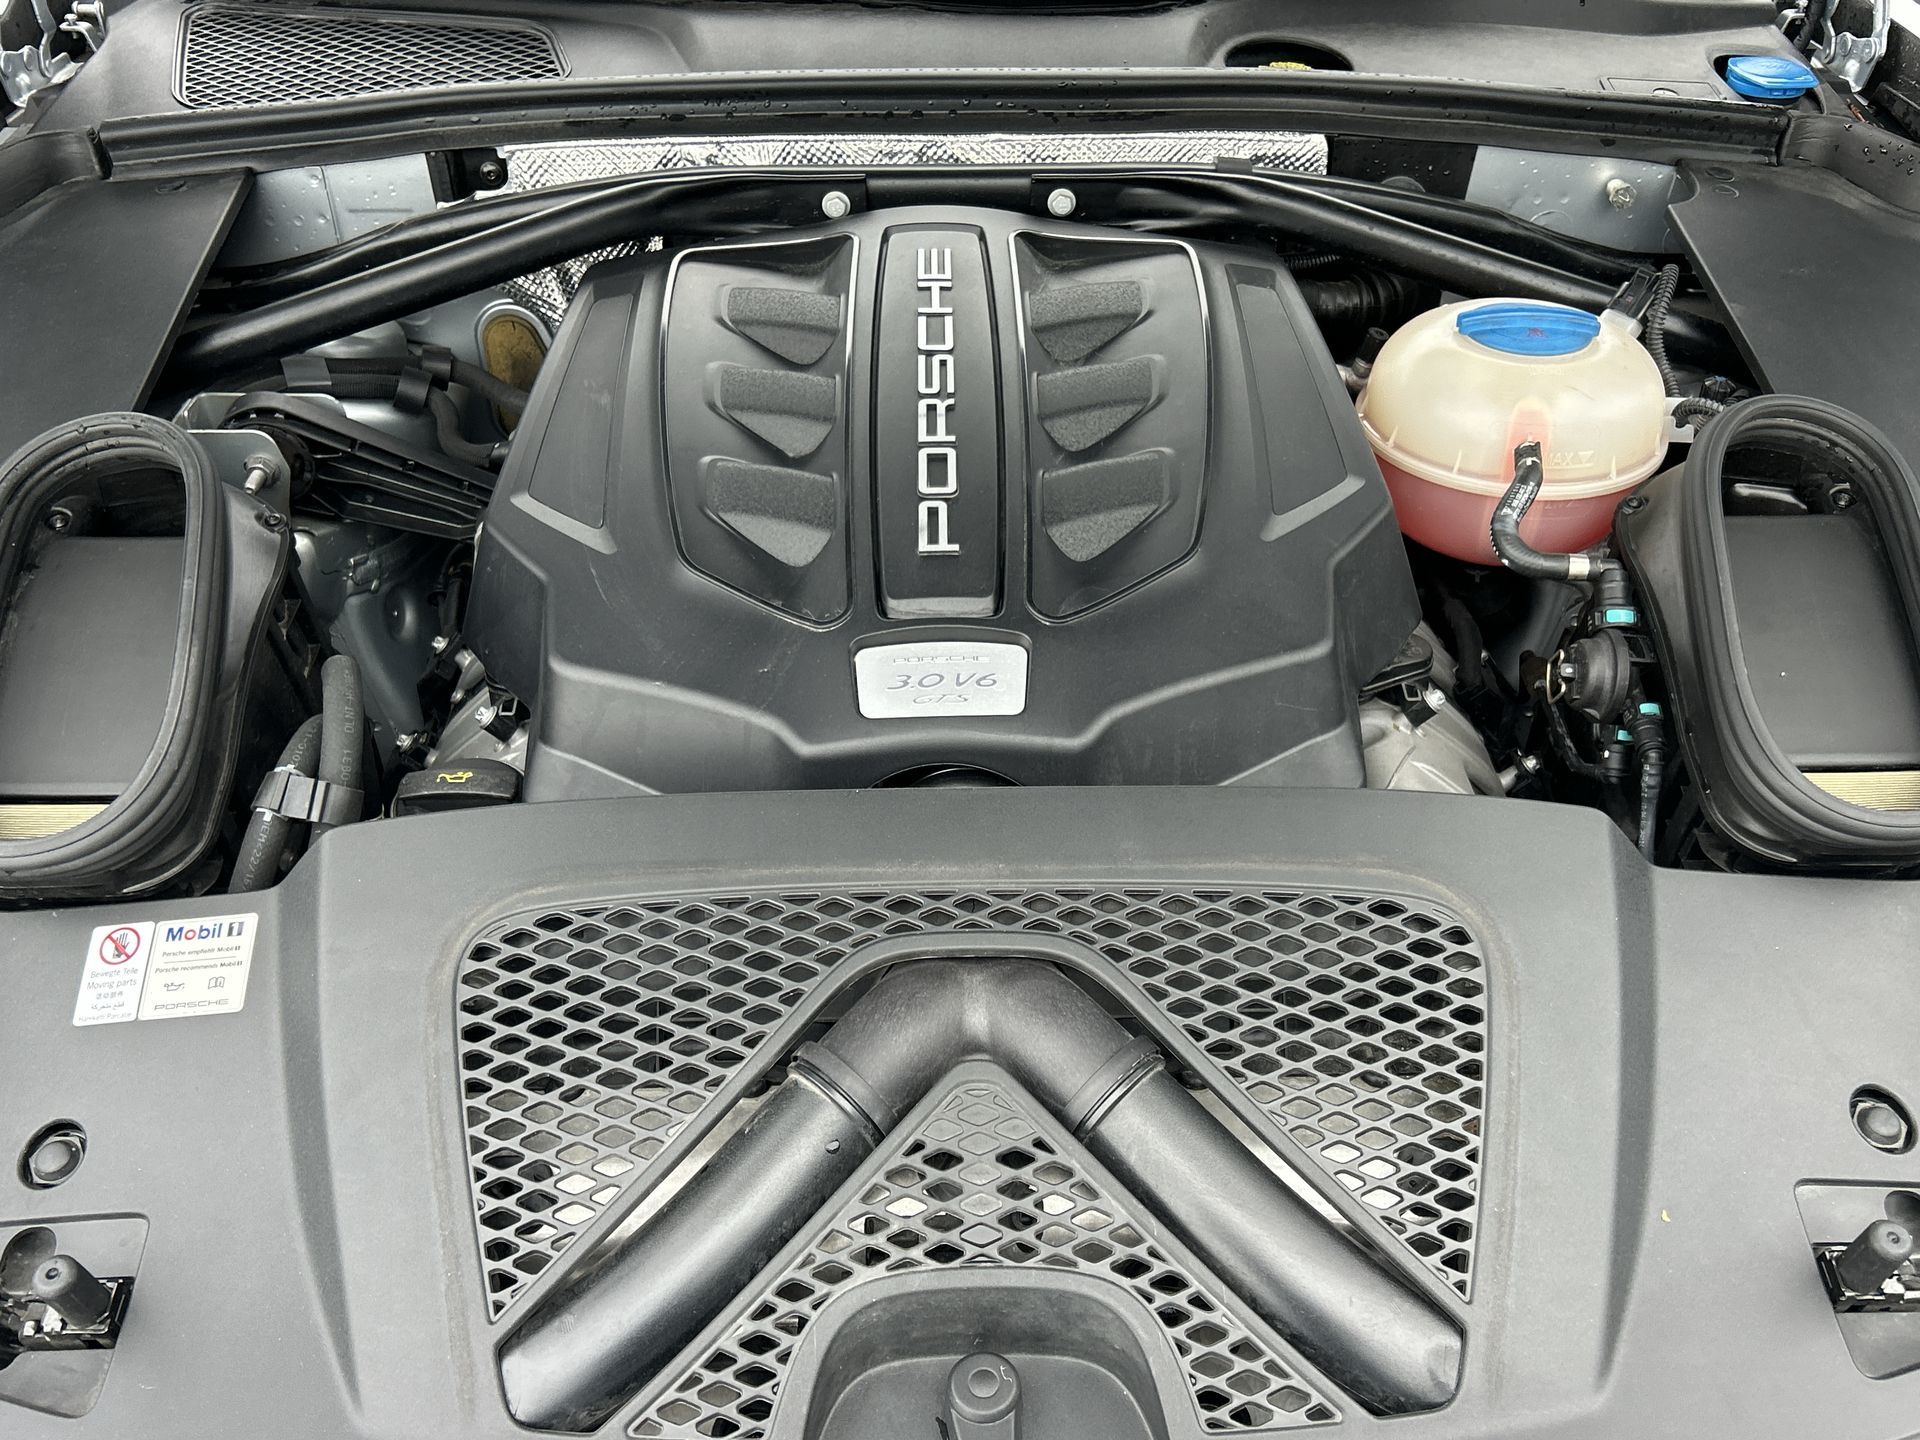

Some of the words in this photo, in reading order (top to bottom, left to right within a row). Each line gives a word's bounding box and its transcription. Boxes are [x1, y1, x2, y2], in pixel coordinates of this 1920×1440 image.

[917, 248, 960, 555] PORSCHE
[893, 655, 990, 664] PORSCHE
[887, 673, 945, 690] 3.0
[955, 672, 998, 688] V6
[913, 694, 969, 704] GTS
[165, 923, 223, 942] Mobil
[226, 921, 245, 938] 1
[162, 948, 186, 957] Porsche
[217, 945, 234, 953] Mobil
[90, 968, 120, 979] Bewegte
[124, 967, 138, 975] Teile
[155, 966, 179, 974] Porsche
[180, 963, 218, 972] recommends
[87, 981, 115, 990] Moving
[116, 979, 137, 988] parts
[153, 998, 230, 1011] PORSCHE
